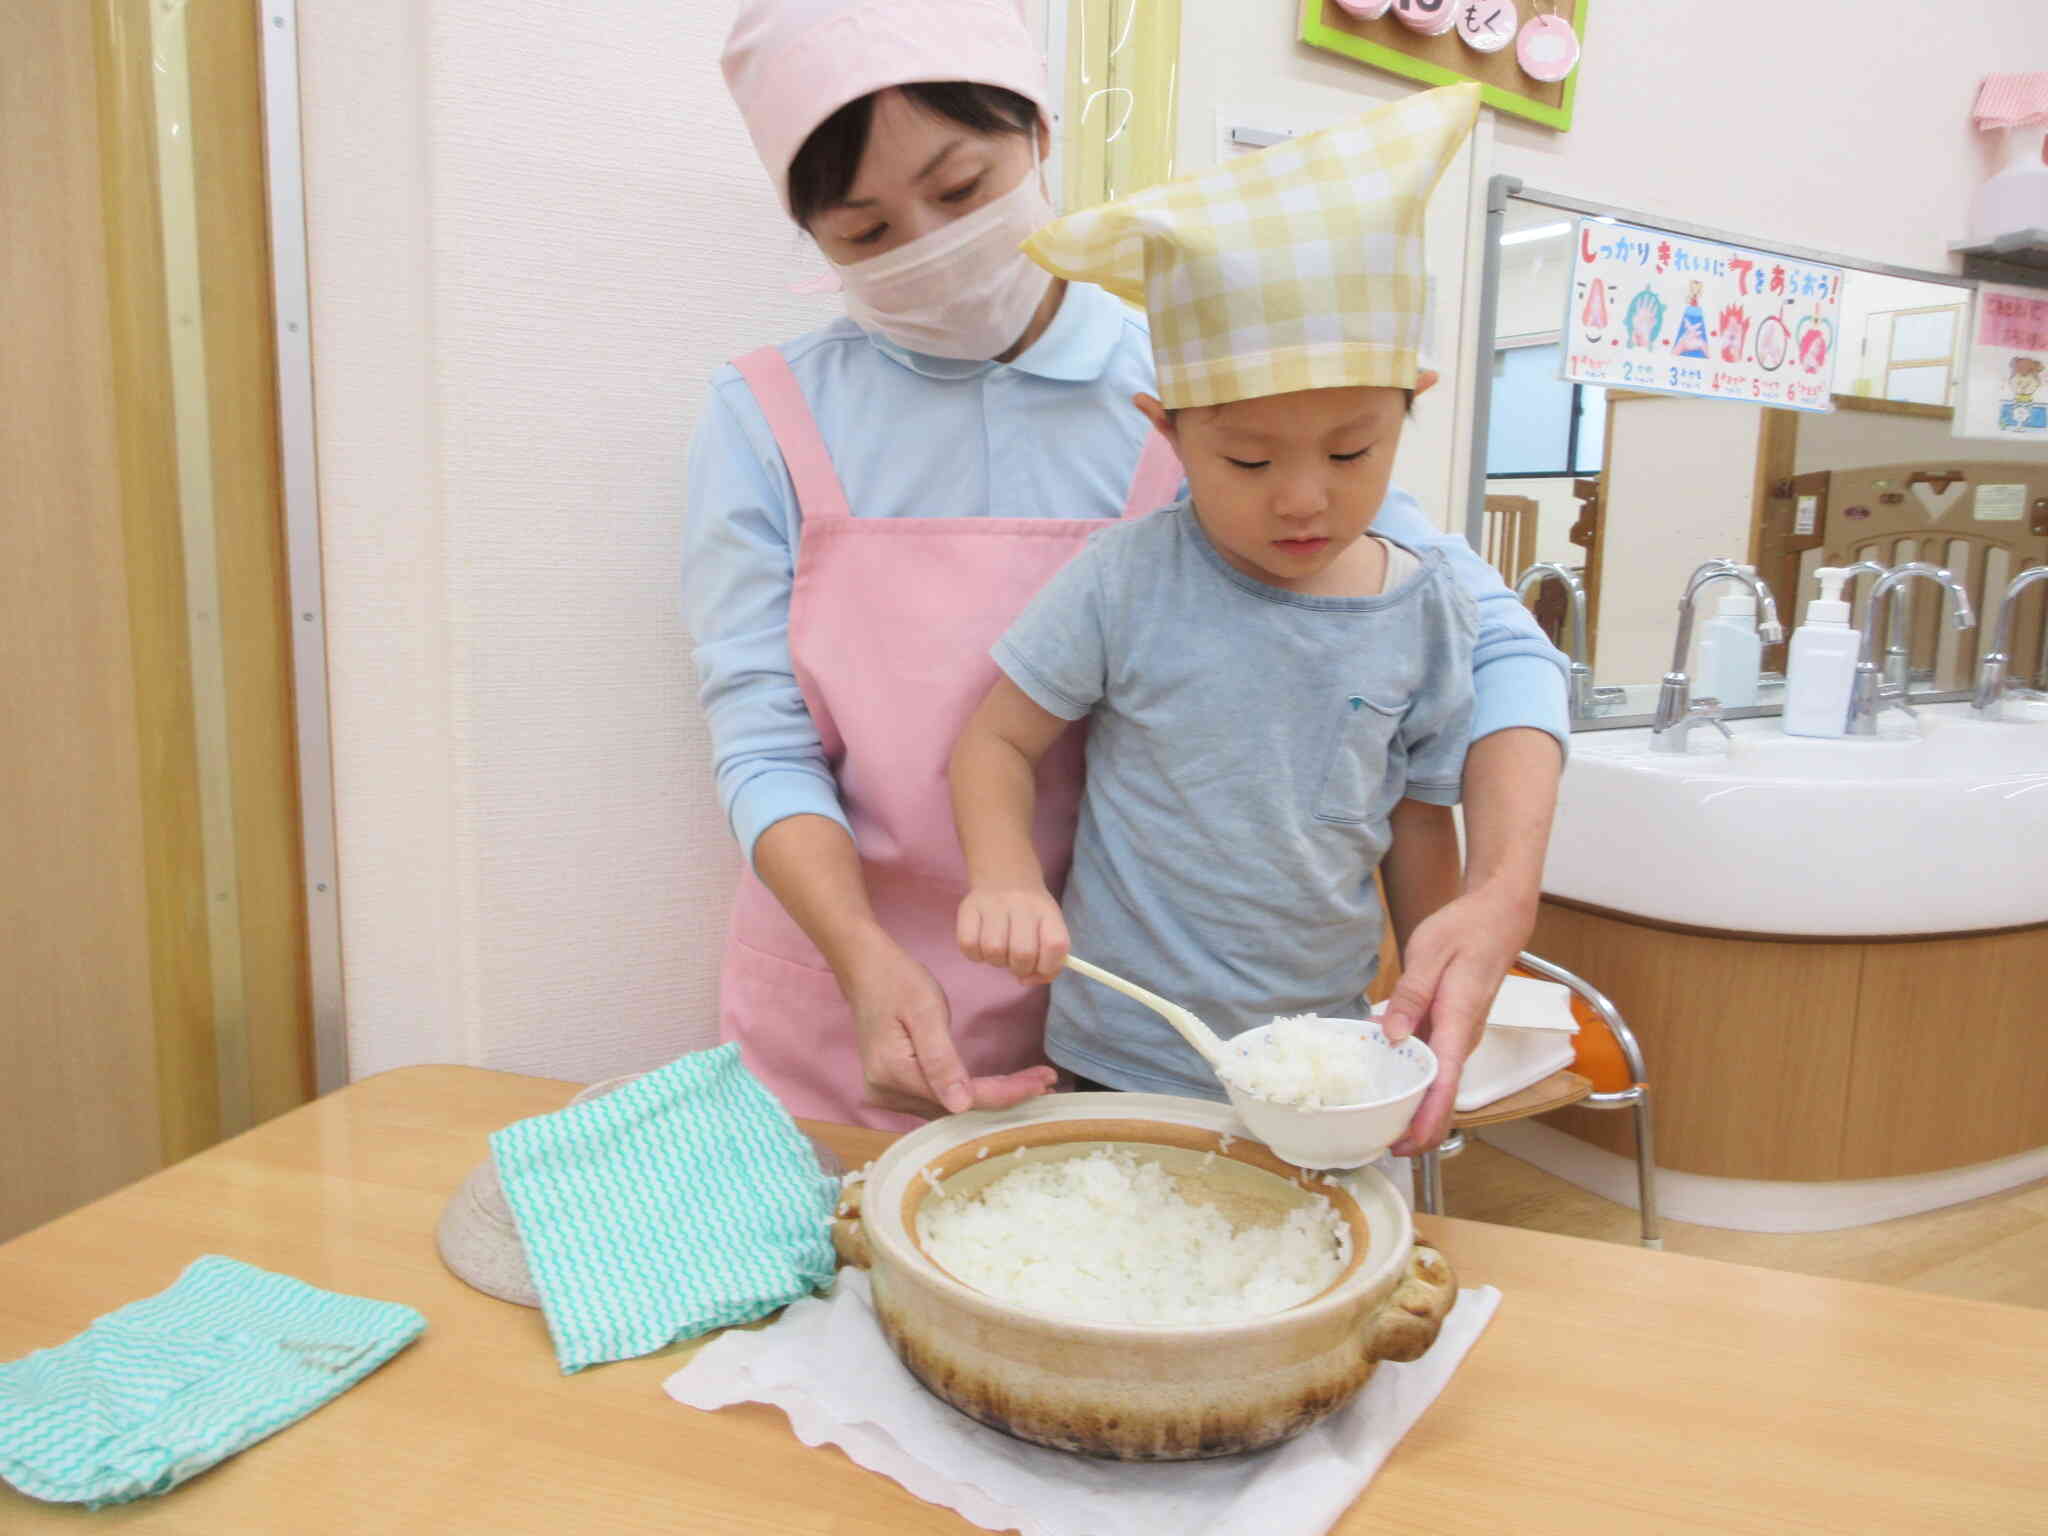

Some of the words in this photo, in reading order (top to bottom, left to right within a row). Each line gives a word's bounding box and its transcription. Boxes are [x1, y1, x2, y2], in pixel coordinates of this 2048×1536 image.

[1464, 5, 1502, 34] もく
[1623, 361, 1633, 380] 2
[1669, 367, 1679, 386] 3
